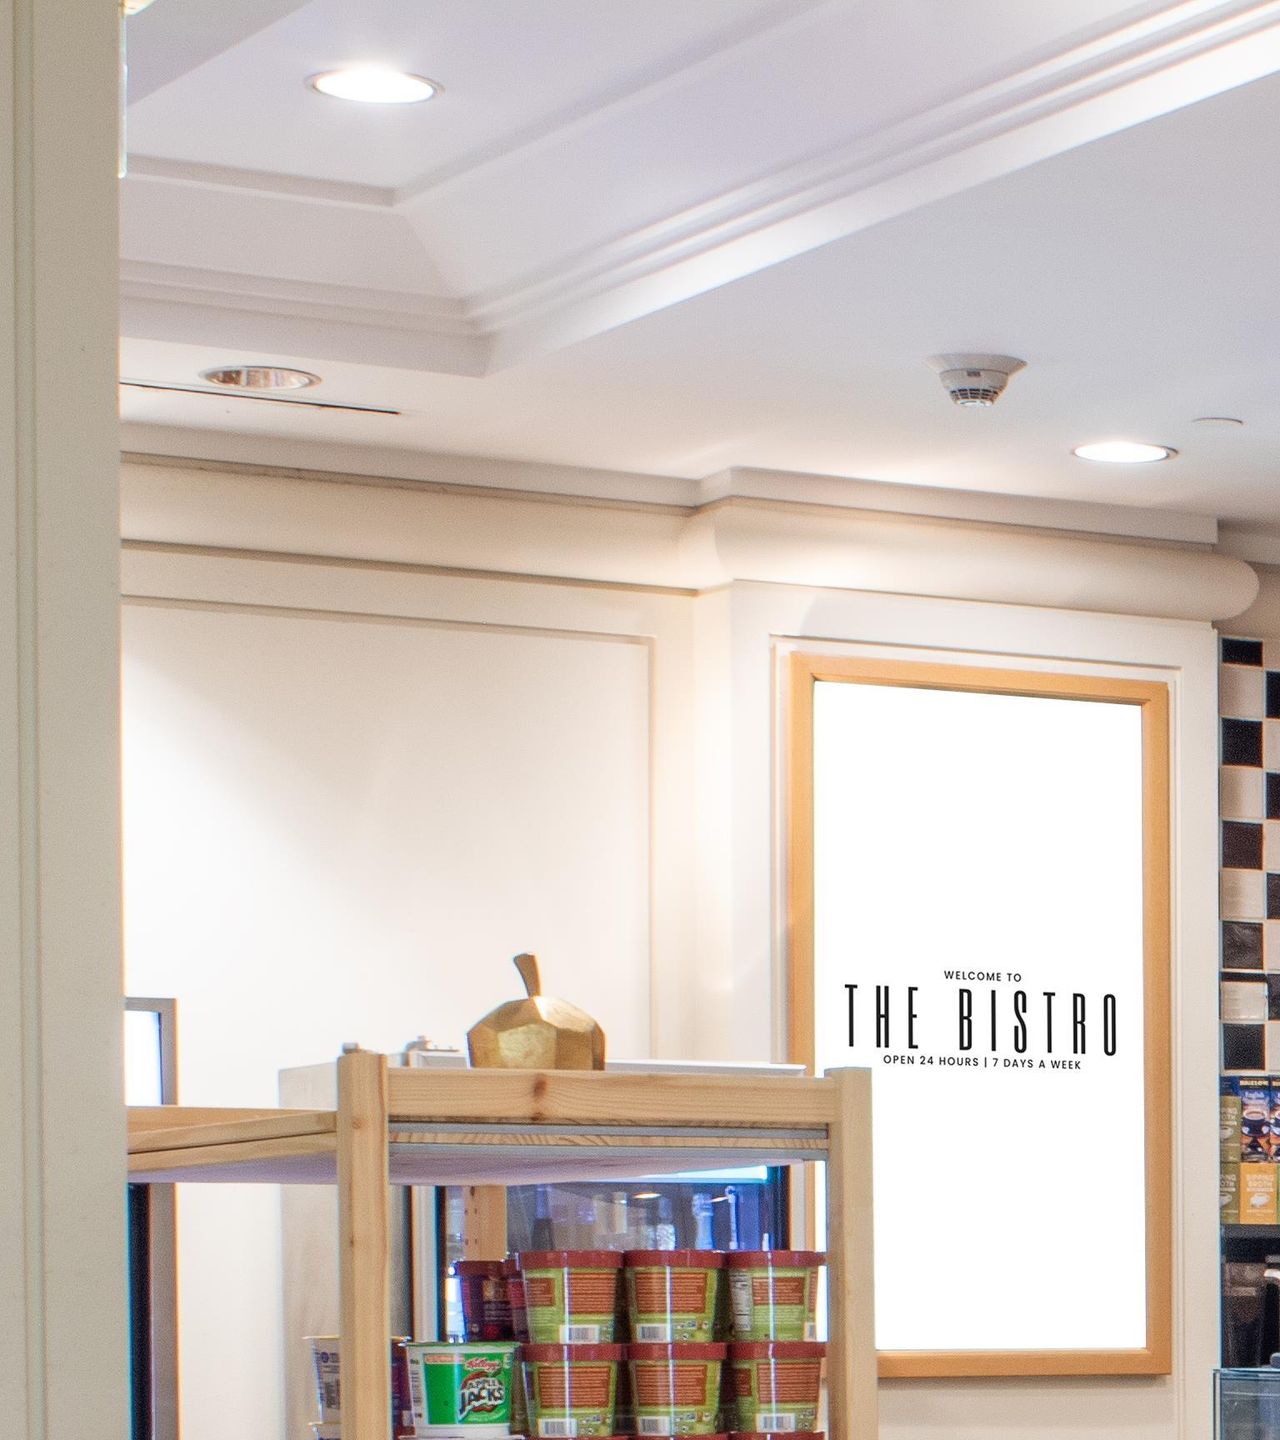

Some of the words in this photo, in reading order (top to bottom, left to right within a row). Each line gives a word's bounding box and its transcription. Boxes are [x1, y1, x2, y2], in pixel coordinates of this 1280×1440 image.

[944, 970, 1001, 982] WELCOME
[1007, 973, 1022, 983] TO
[844, 984, 918, 1049] THE
[959, 988, 1117, 1057] BISTRO
[883, 1055, 915, 1065] OPEN
[919, 1056, 934, 1065] 24
[939, 1056, 979, 1067] HOURS
[992, 1057, 999, 1068] 7
[1003, 1058, 1034, 1069] DAYS
[1038, 1059, 1046, 1069] A
[1050, 1060, 1081, 1070] WEEK
